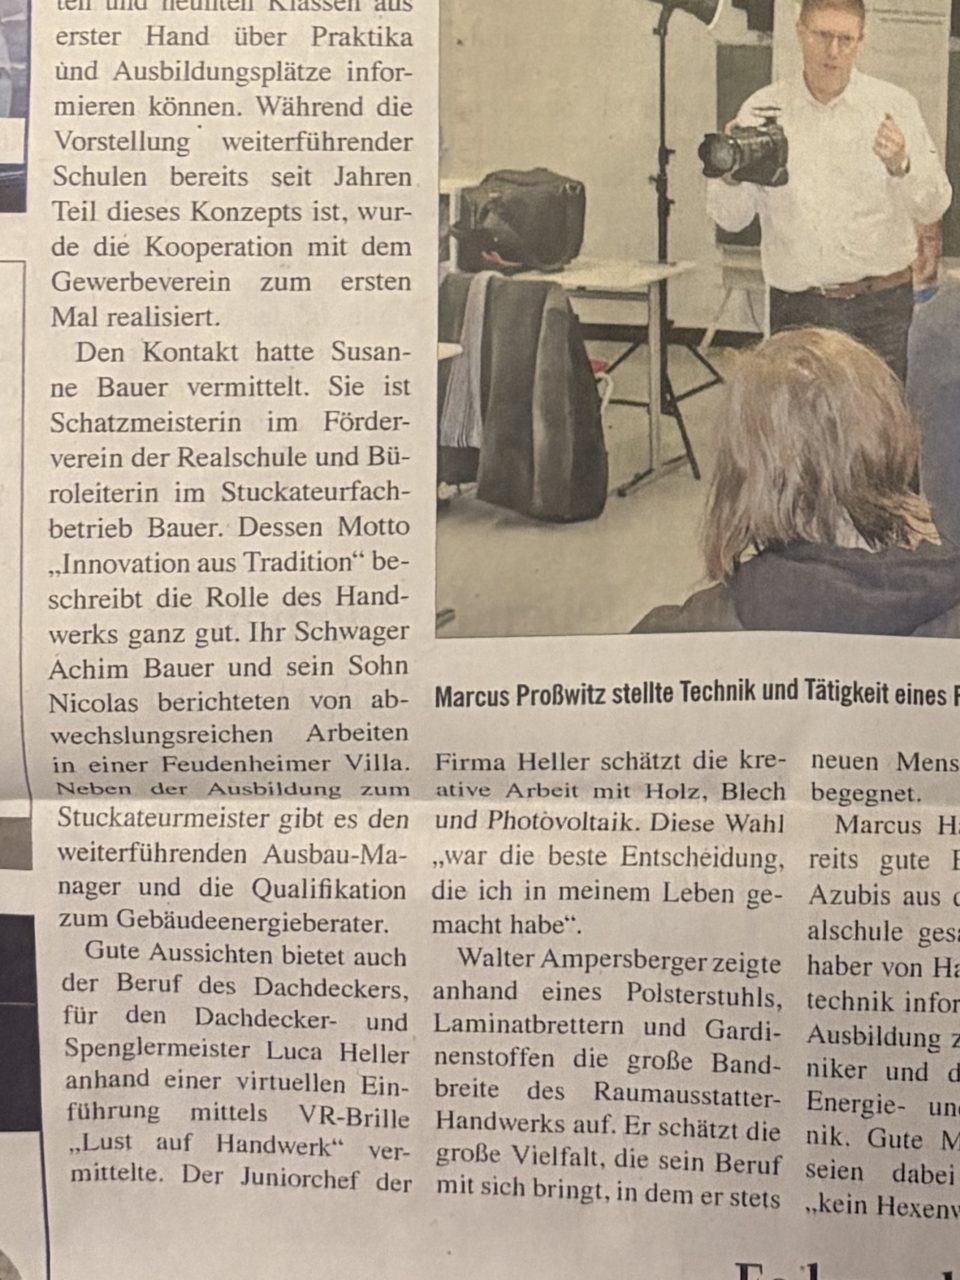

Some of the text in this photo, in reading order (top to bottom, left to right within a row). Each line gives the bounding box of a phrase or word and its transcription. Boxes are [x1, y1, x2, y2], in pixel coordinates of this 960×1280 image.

[53, 164, 412, 188] Schulen bereits seit Jahren
[51, 269, 412, 293] Gewerbeverein zum ersten
[50, 409, 411, 434] Schatzmeisterin im Förder-
[435, 685, 510, 709] Marcus
[516, 682, 607, 707] Proßwitz
[611, 680, 674, 705] stellte
[679, 677, 757, 703] Technik
[762, 677, 799, 701] und
[803, 677, 890, 708] Tätigkeit
[894, 682, 948, 707] eines
[435, 748, 787, 772] Firma Heller schätzt die kre-
[55, 780, 411, 801] Neben der Ausbildung zum
[834, 814, 922, 835] Marcus
[432, 979, 783, 1013] anhand eines Polsterstuhls,
[806, 1023, 942, 1055] Ausbildung
[66, 1100, 410, 1129] führung mittels VR-Brille
[806, 1123, 851, 1148] nik.
[867, 1126, 924, 1151] Gute
[435, 1142, 784, 1176] große Vielfalt, die sein Beruf
